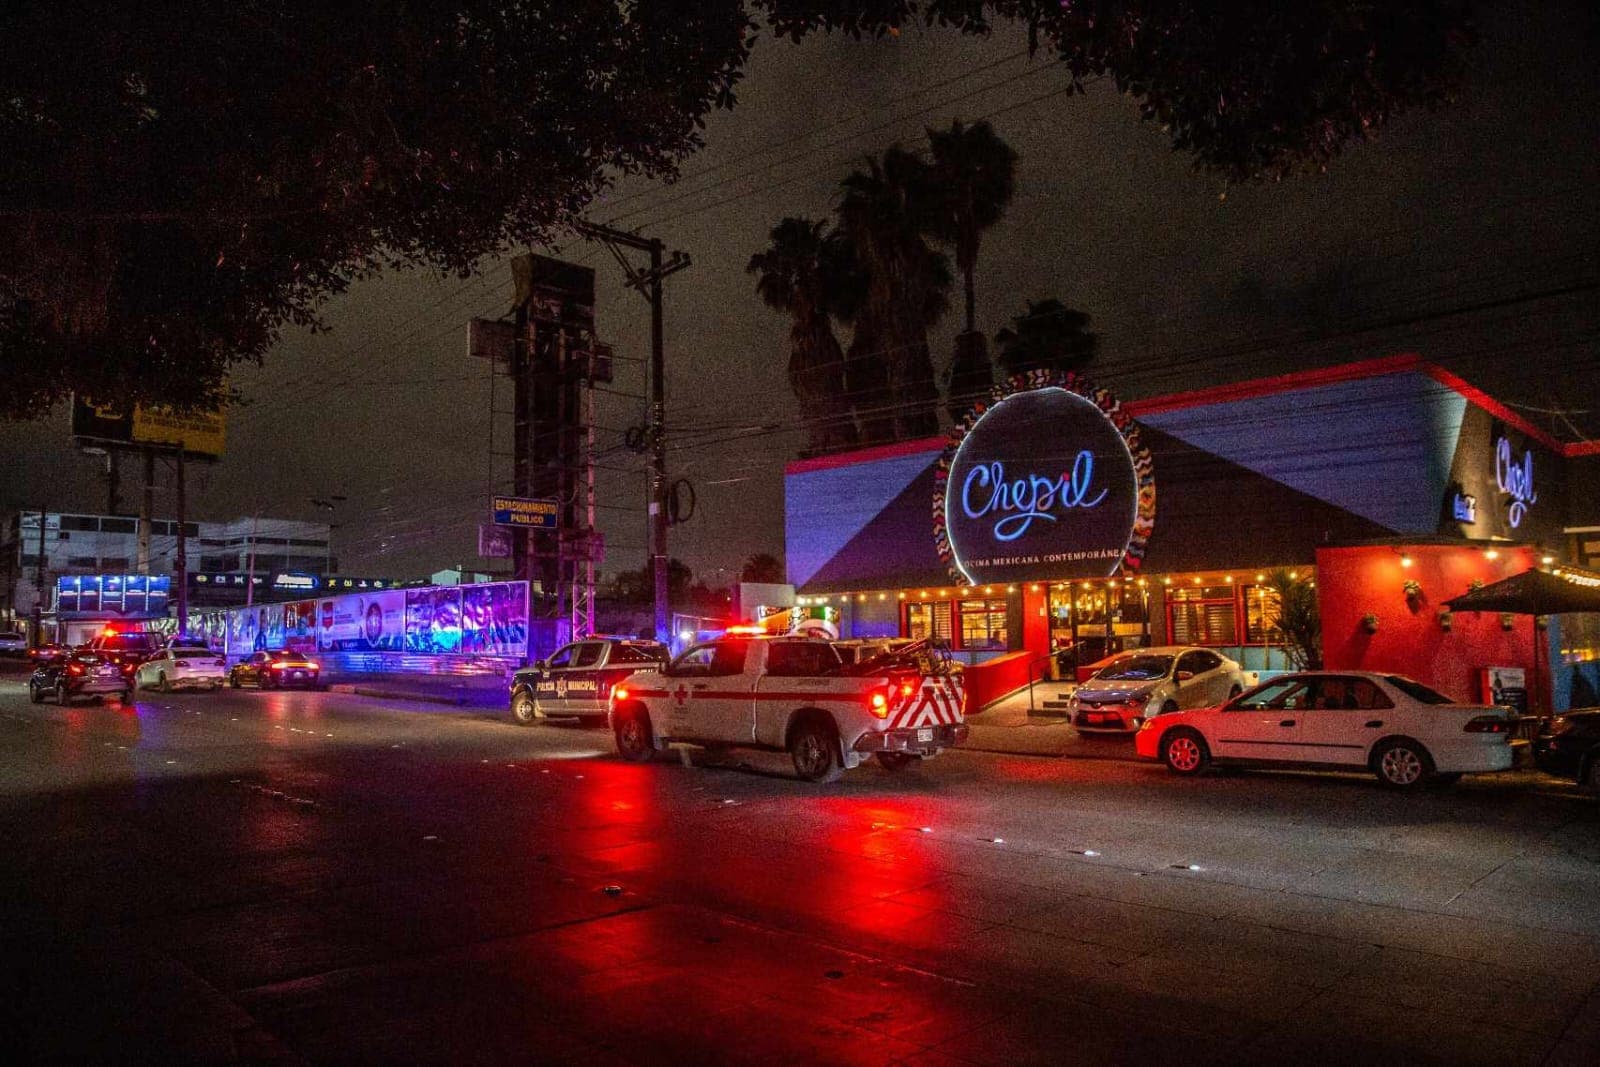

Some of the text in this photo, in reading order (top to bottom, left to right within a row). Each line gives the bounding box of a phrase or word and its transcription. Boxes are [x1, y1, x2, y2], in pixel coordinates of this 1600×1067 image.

[963, 450, 1108, 541] Chepil
[496, 499, 557, 514] ESTACIONAMIENTO
[992, 556, 1040, 567] MEXICANA
[567, 680, 597, 692] MUNICIPAL
